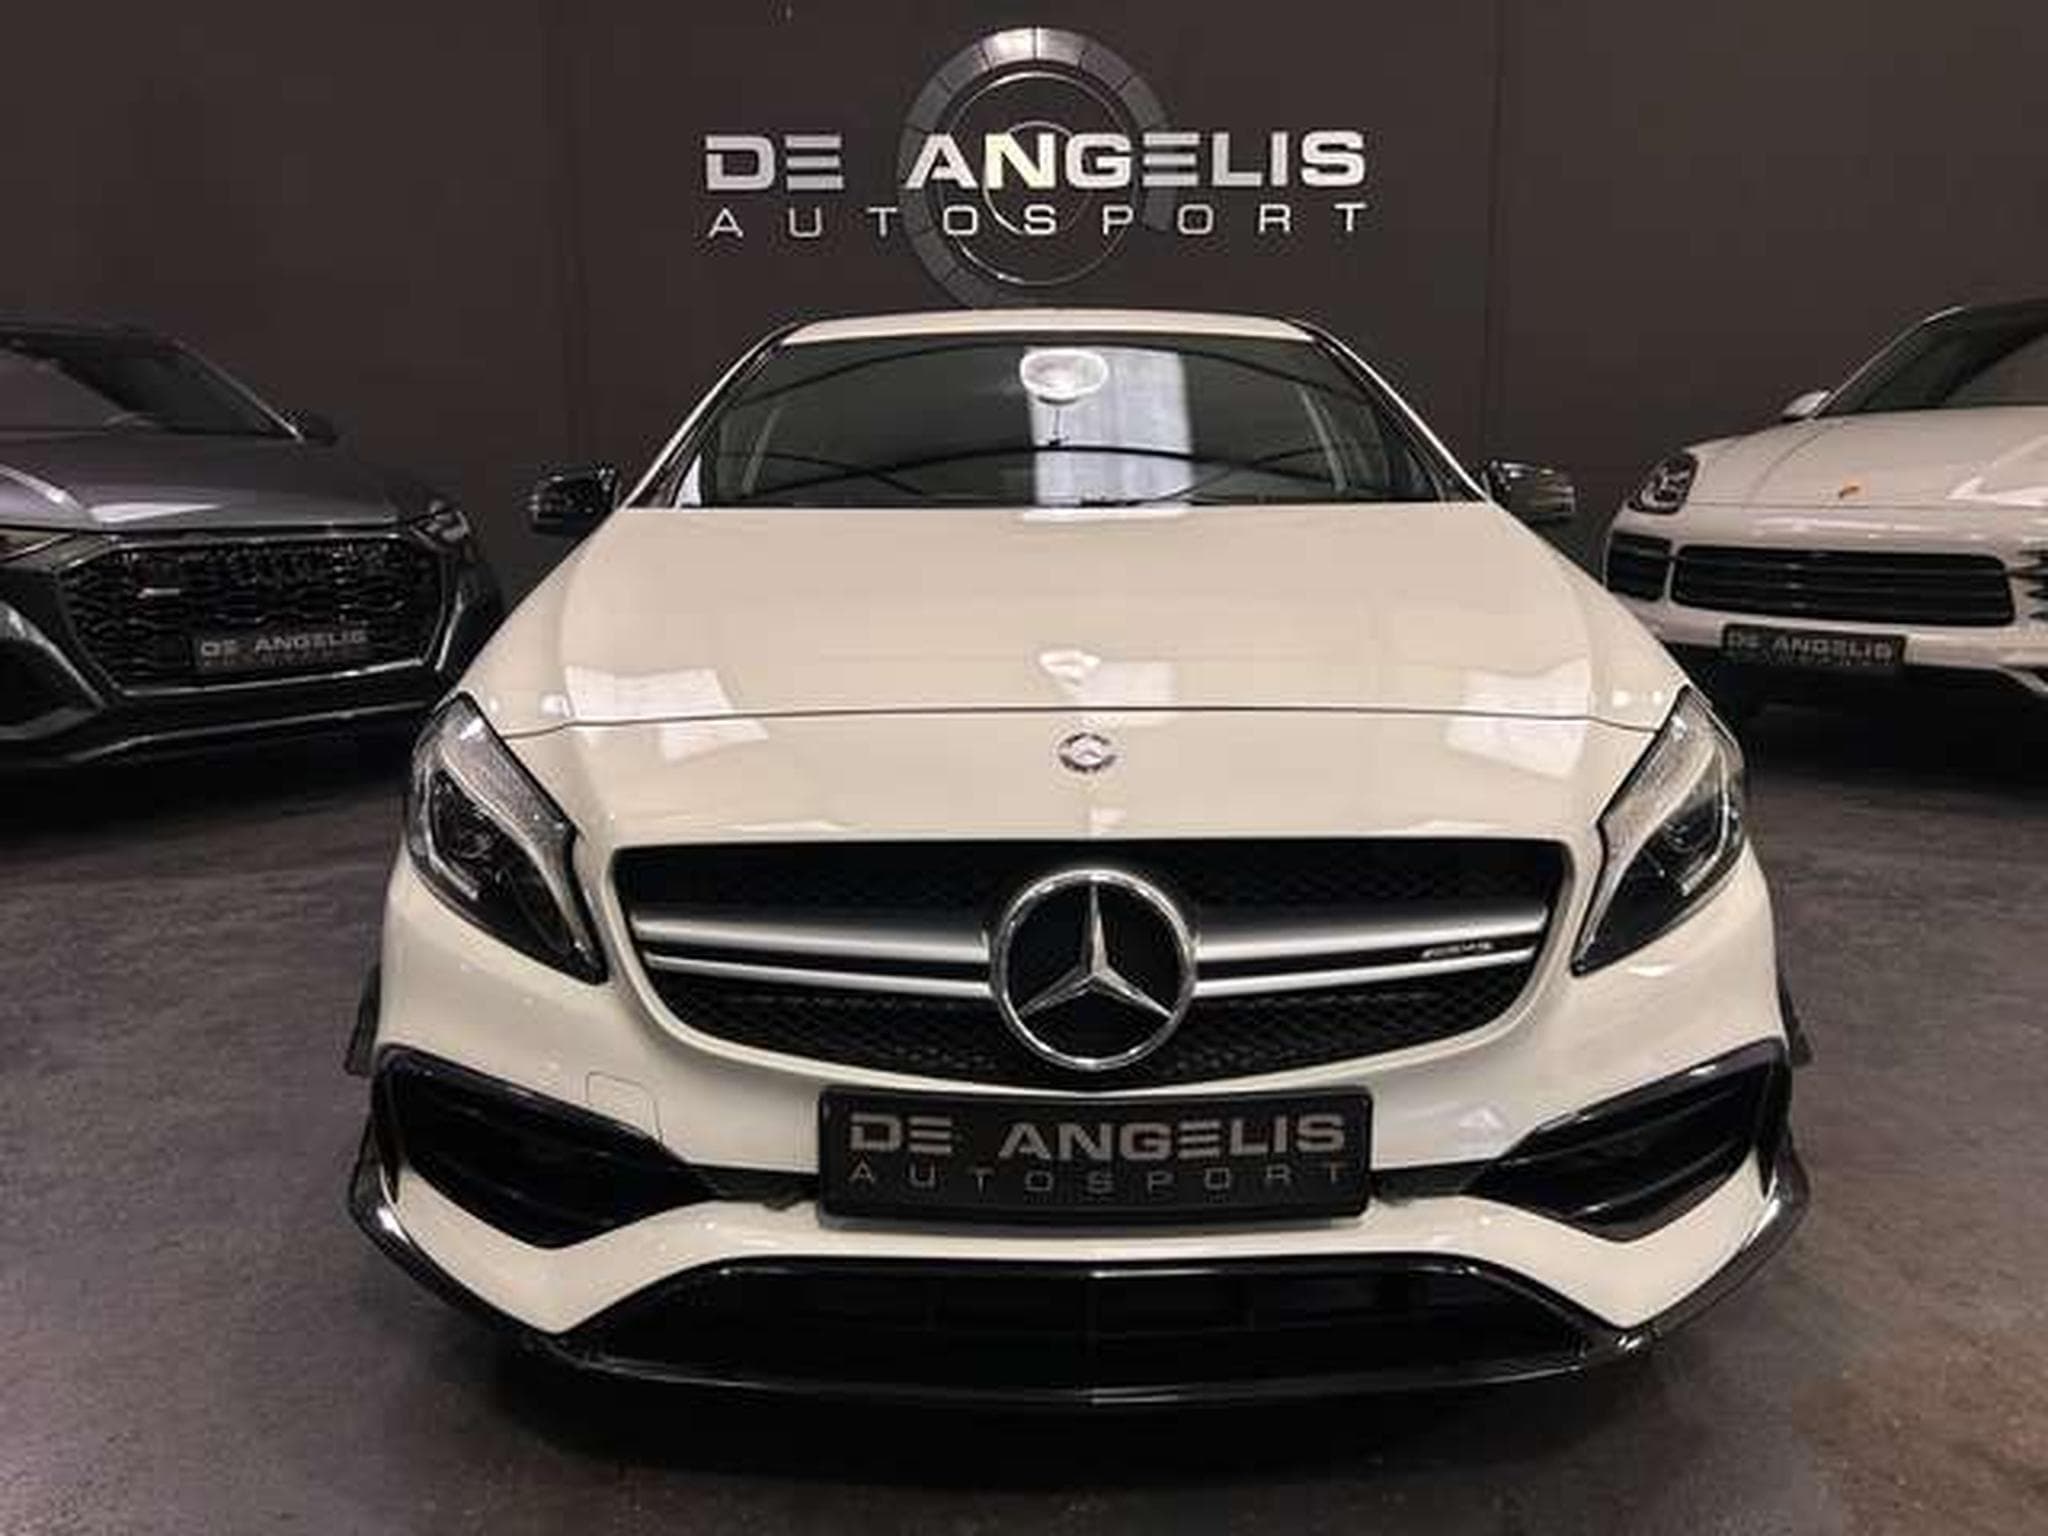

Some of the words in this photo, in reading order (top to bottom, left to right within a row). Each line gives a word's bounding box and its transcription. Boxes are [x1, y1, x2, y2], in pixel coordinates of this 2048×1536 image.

[704, 134, 844, 191] DE
[905, 129, 1367, 190] ANGELIS
[707, 202, 1368, 238] AUTOSPORT
[849, 1113, 952, 1155] DE
[999, 1113, 1346, 1161] ANGELIS
[848, 1161, 1348, 1195] AUTOSPORT
